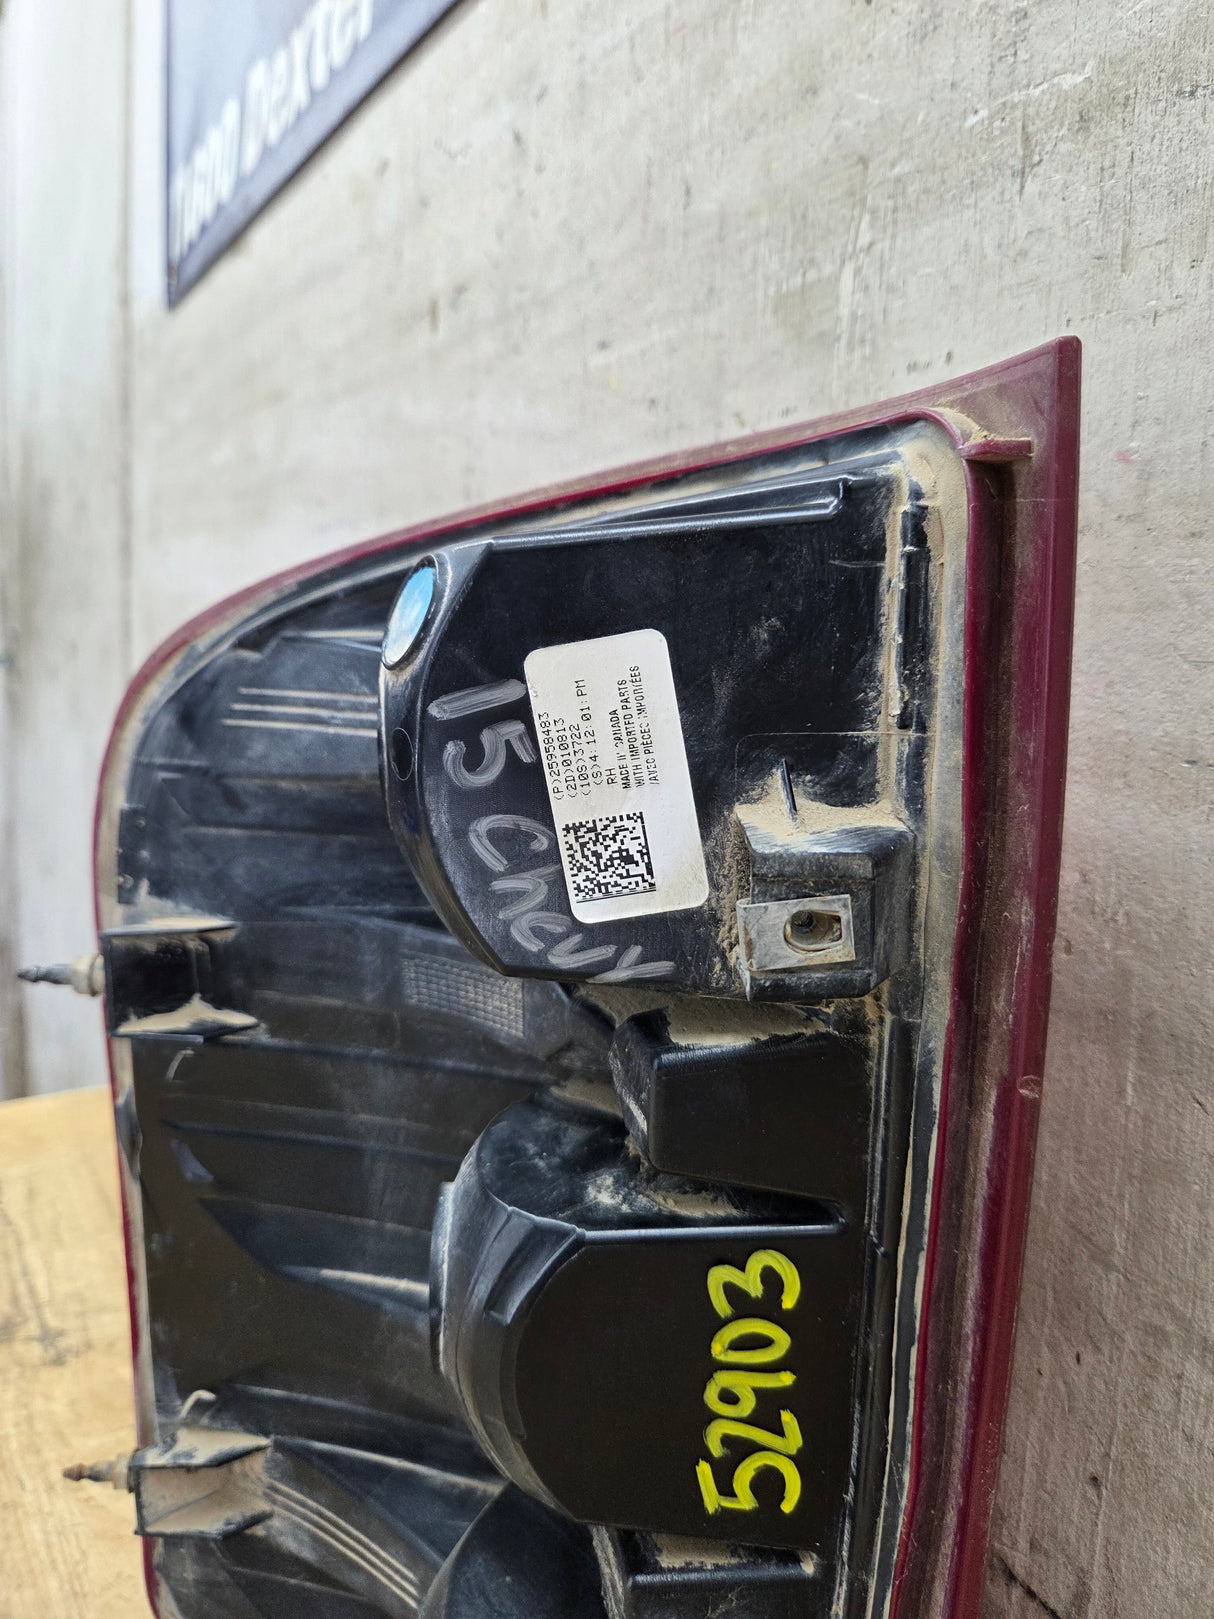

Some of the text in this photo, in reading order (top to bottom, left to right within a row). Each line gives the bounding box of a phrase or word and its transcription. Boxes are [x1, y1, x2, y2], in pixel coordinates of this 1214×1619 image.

[616, 679, 632, 711] PARTS
[427, 679, 537, 789] 15
[537, 711, 565, 800] (P)25958483
[553, 717, 578, 798] (2D)010813
[568, 723, 592, 796] (10S)3722
[604, 767, 618, 785] RH
[631, 763, 646, 788] WITH
[696, 1249, 803, 1515] 52903
